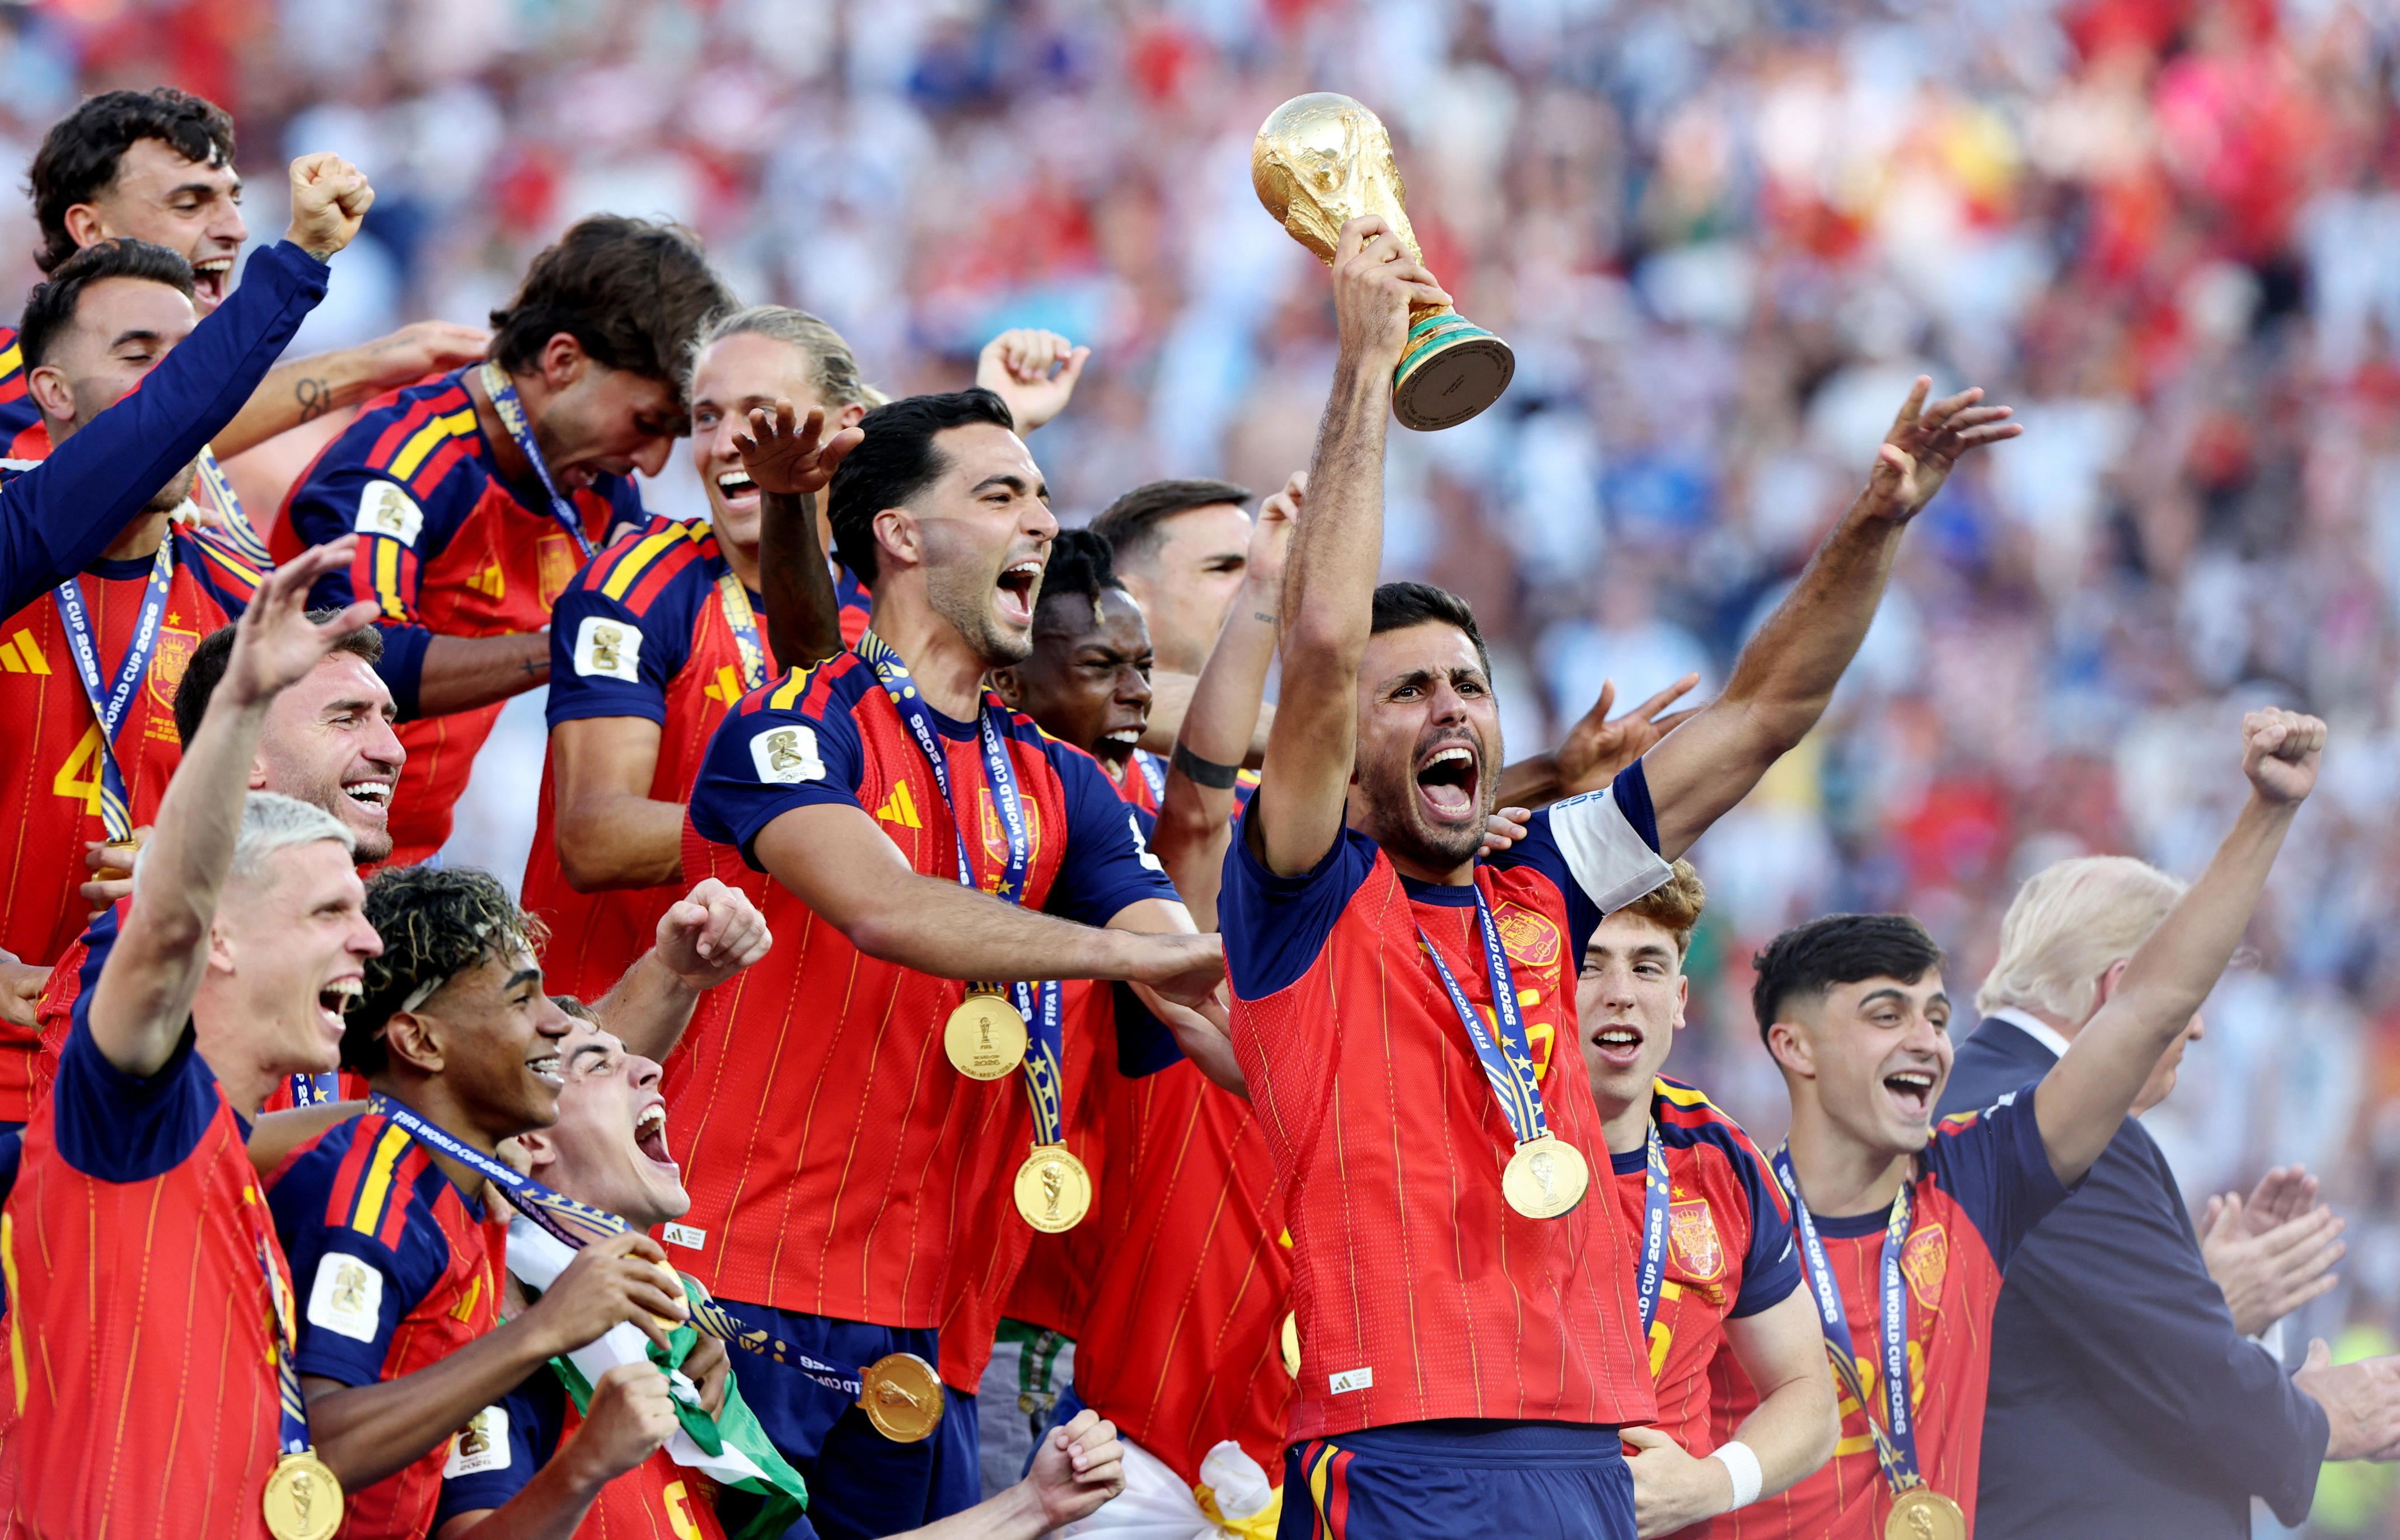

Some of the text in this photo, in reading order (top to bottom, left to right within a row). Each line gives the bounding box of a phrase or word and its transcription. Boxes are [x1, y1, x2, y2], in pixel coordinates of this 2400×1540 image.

[67, 601, 85, 632] CUP
[75, 633, 100, 687] 2026
[122, 651, 143, 682] CUP
[135, 601, 159, 654] 2026
[910, 713, 942, 764] 2026
[981, 706, 1026, 870] FIFA WORLD CUP 2026
[1481, 908, 1500, 953] WORLD
[1492, 953, 1507, 980] CUP
[1016, 981, 1033, 1023] 026
[1045, 993, 1057, 1027] FIFA
[1443, 970, 1473, 1019] WORLD
[1497, 980, 1517, 1026] 2026
[1470, 1020, 1491, 1050] FIFA
[392, 1110, 524, 1186] FIFA WORLD CUP 2026
[1647, 1207, 1663, 1263] 2026
[1808, 1238, 1825, 1269] CUP
[1641, 1263, 1658, 1294] CUP
[1814, 1268, 1839, 1324] 2026
[1886, 1256, 1907, 1435] FIFA WORLD CUP 2026
